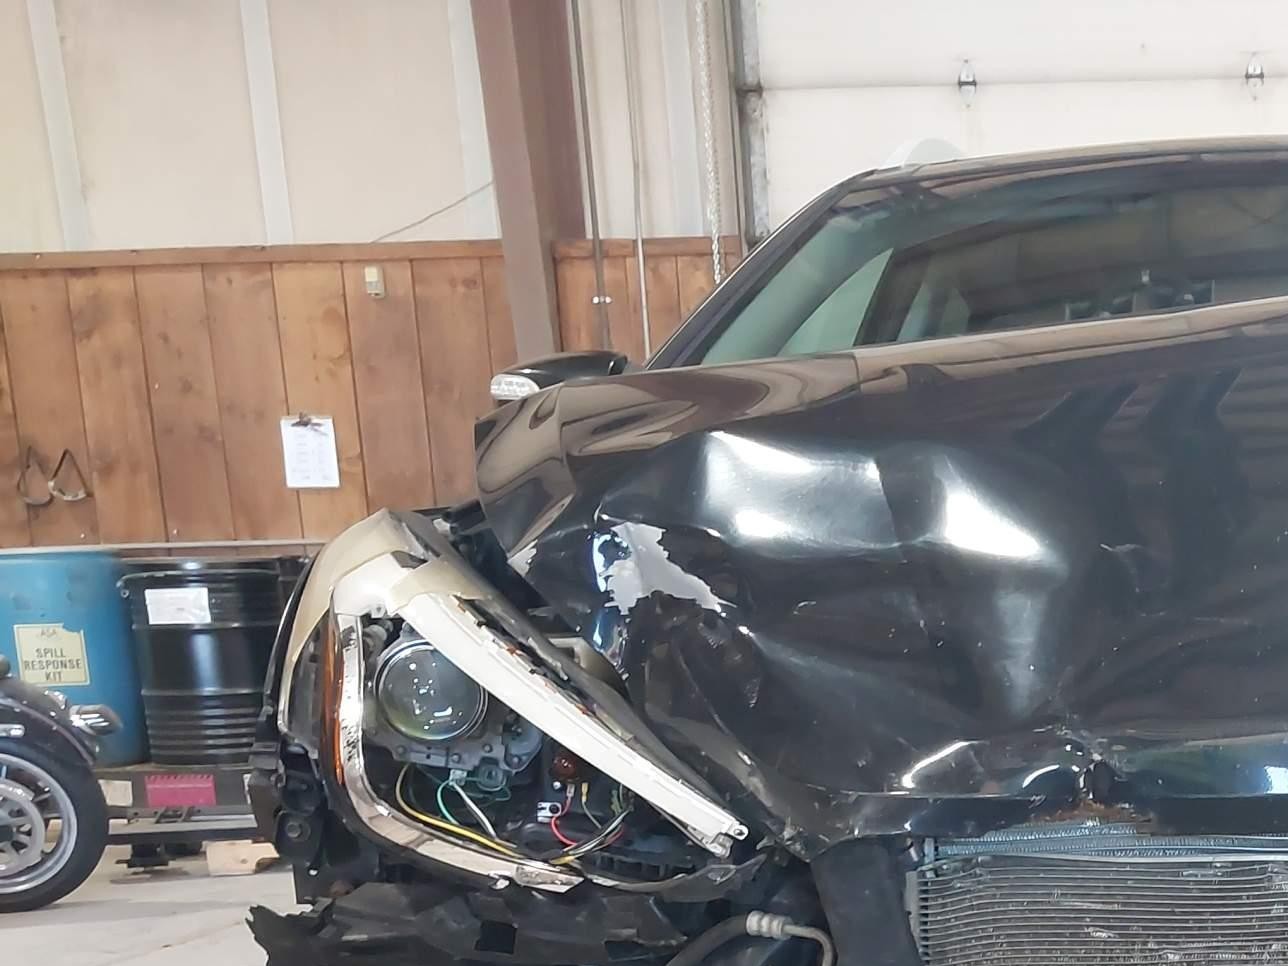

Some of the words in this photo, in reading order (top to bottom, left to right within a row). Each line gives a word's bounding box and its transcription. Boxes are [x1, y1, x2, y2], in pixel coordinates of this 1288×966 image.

[35, 647, 66, 658] SPILL
[23, 659, 82, 670] RESPONSE
[45, 671, 63, 681] KIT
